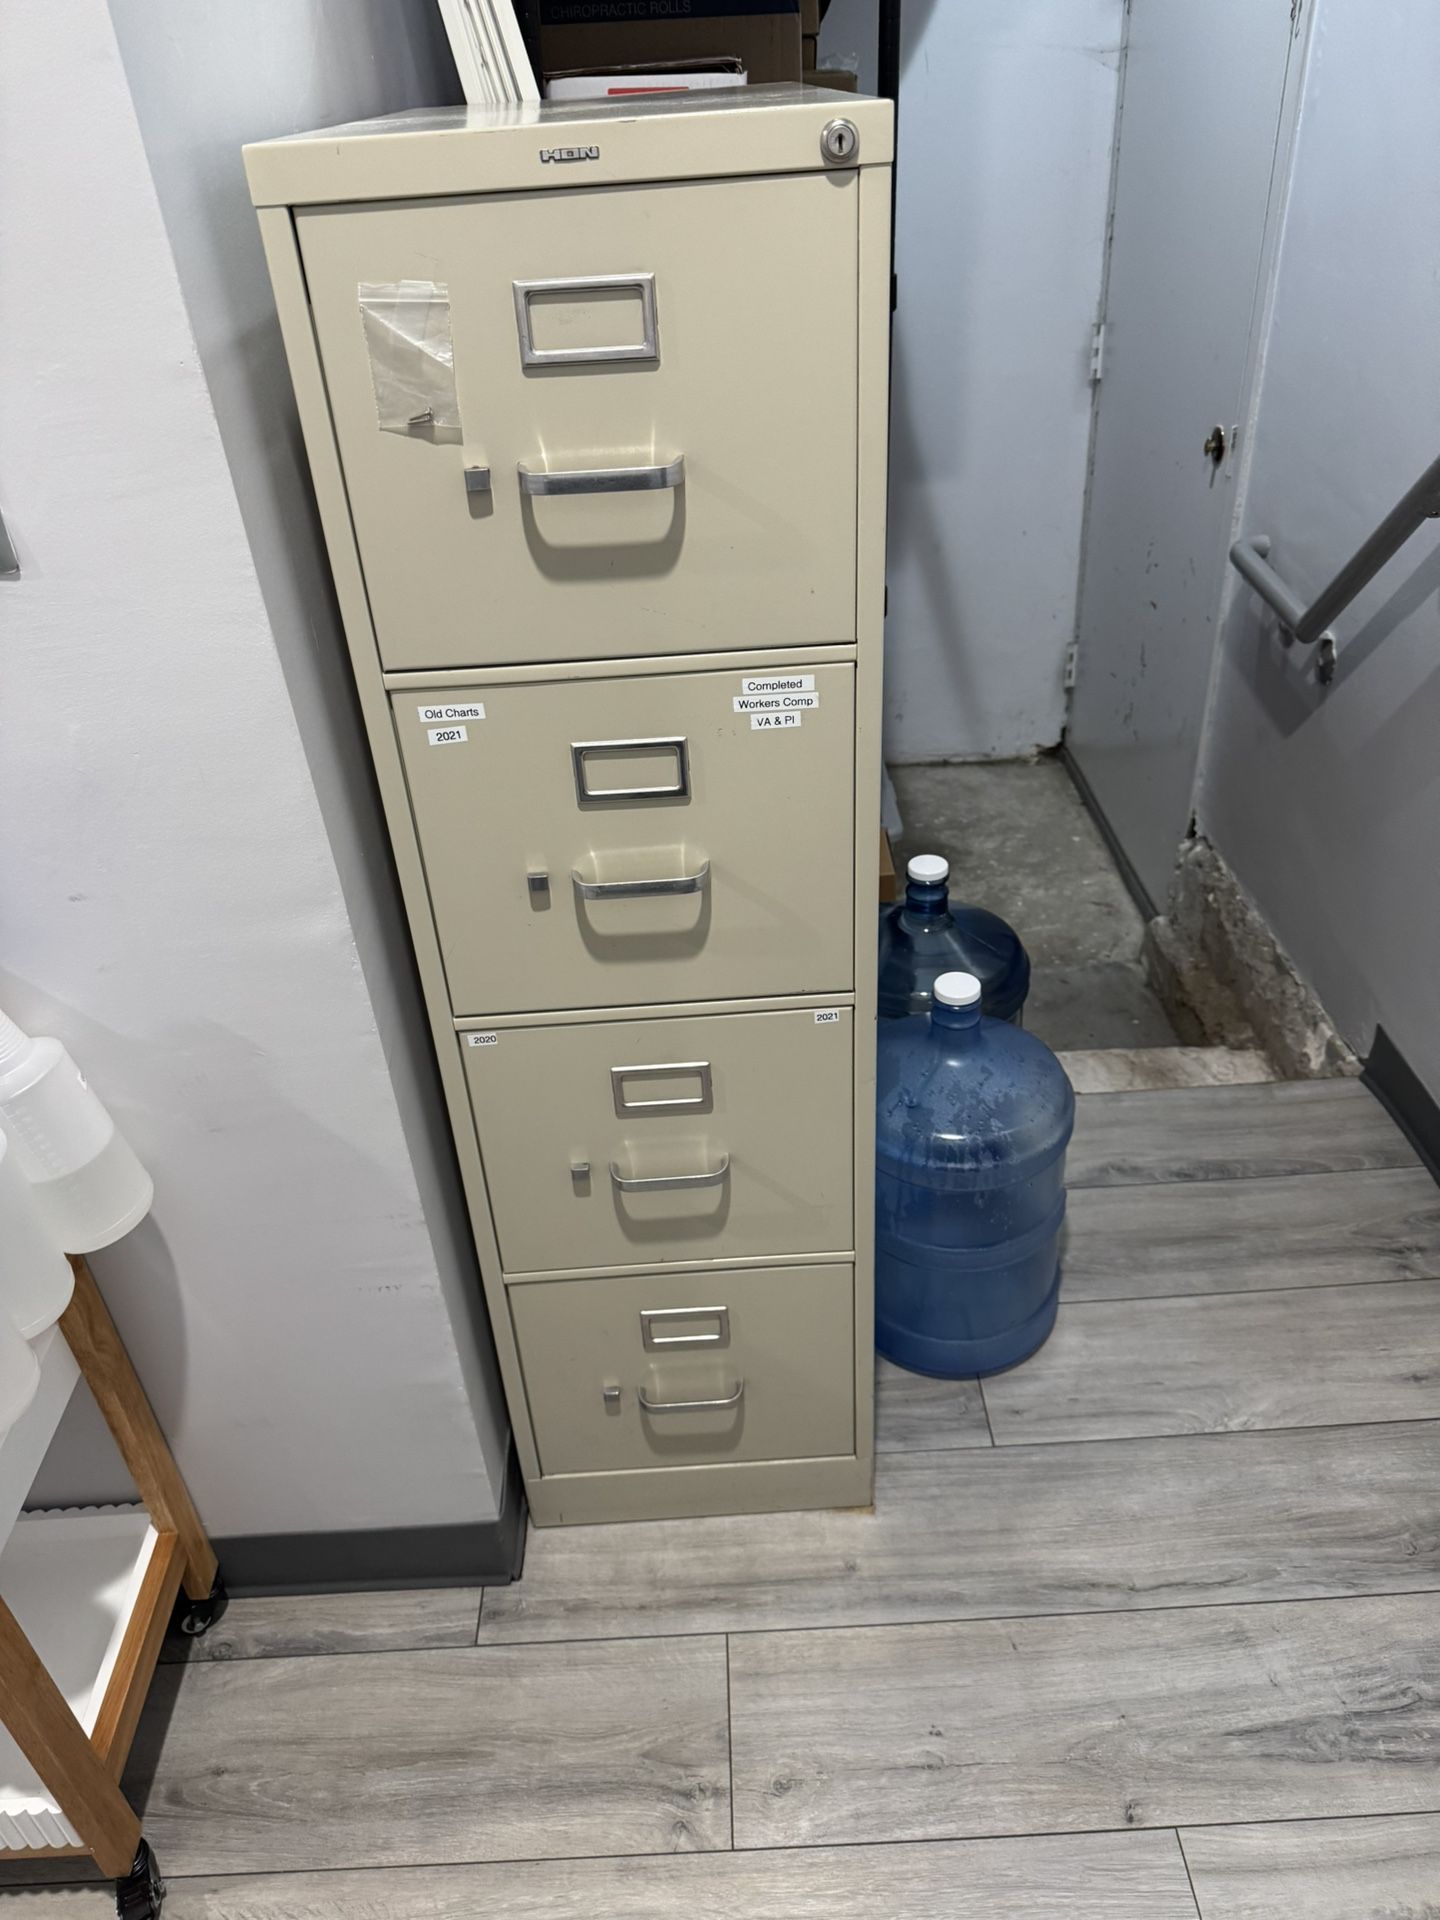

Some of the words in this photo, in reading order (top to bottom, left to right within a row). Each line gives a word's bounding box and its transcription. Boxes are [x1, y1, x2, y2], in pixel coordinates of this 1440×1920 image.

[551, 1, 647, 19] CHIROPRACTIC
[650, 0, 692, 14] ROLLS
[540, 146, 599, 163] HON
[748, 679, 803, 691] Completed
[738, 699, 780, 709] Workers
[783, 697, 814, 706] Comp
[424, 709, 443, 719] Old
[445, 708, 479, 718] Charts
[757, 717, 772, 726] VA
[774, 716, 781, 725] &
[784, 715, 795, 725] PI
[436, 730, 461, 742] 2021
[816, 1012, 838, 1021] 2021
[473, 1035, 497, 1044] 2020
